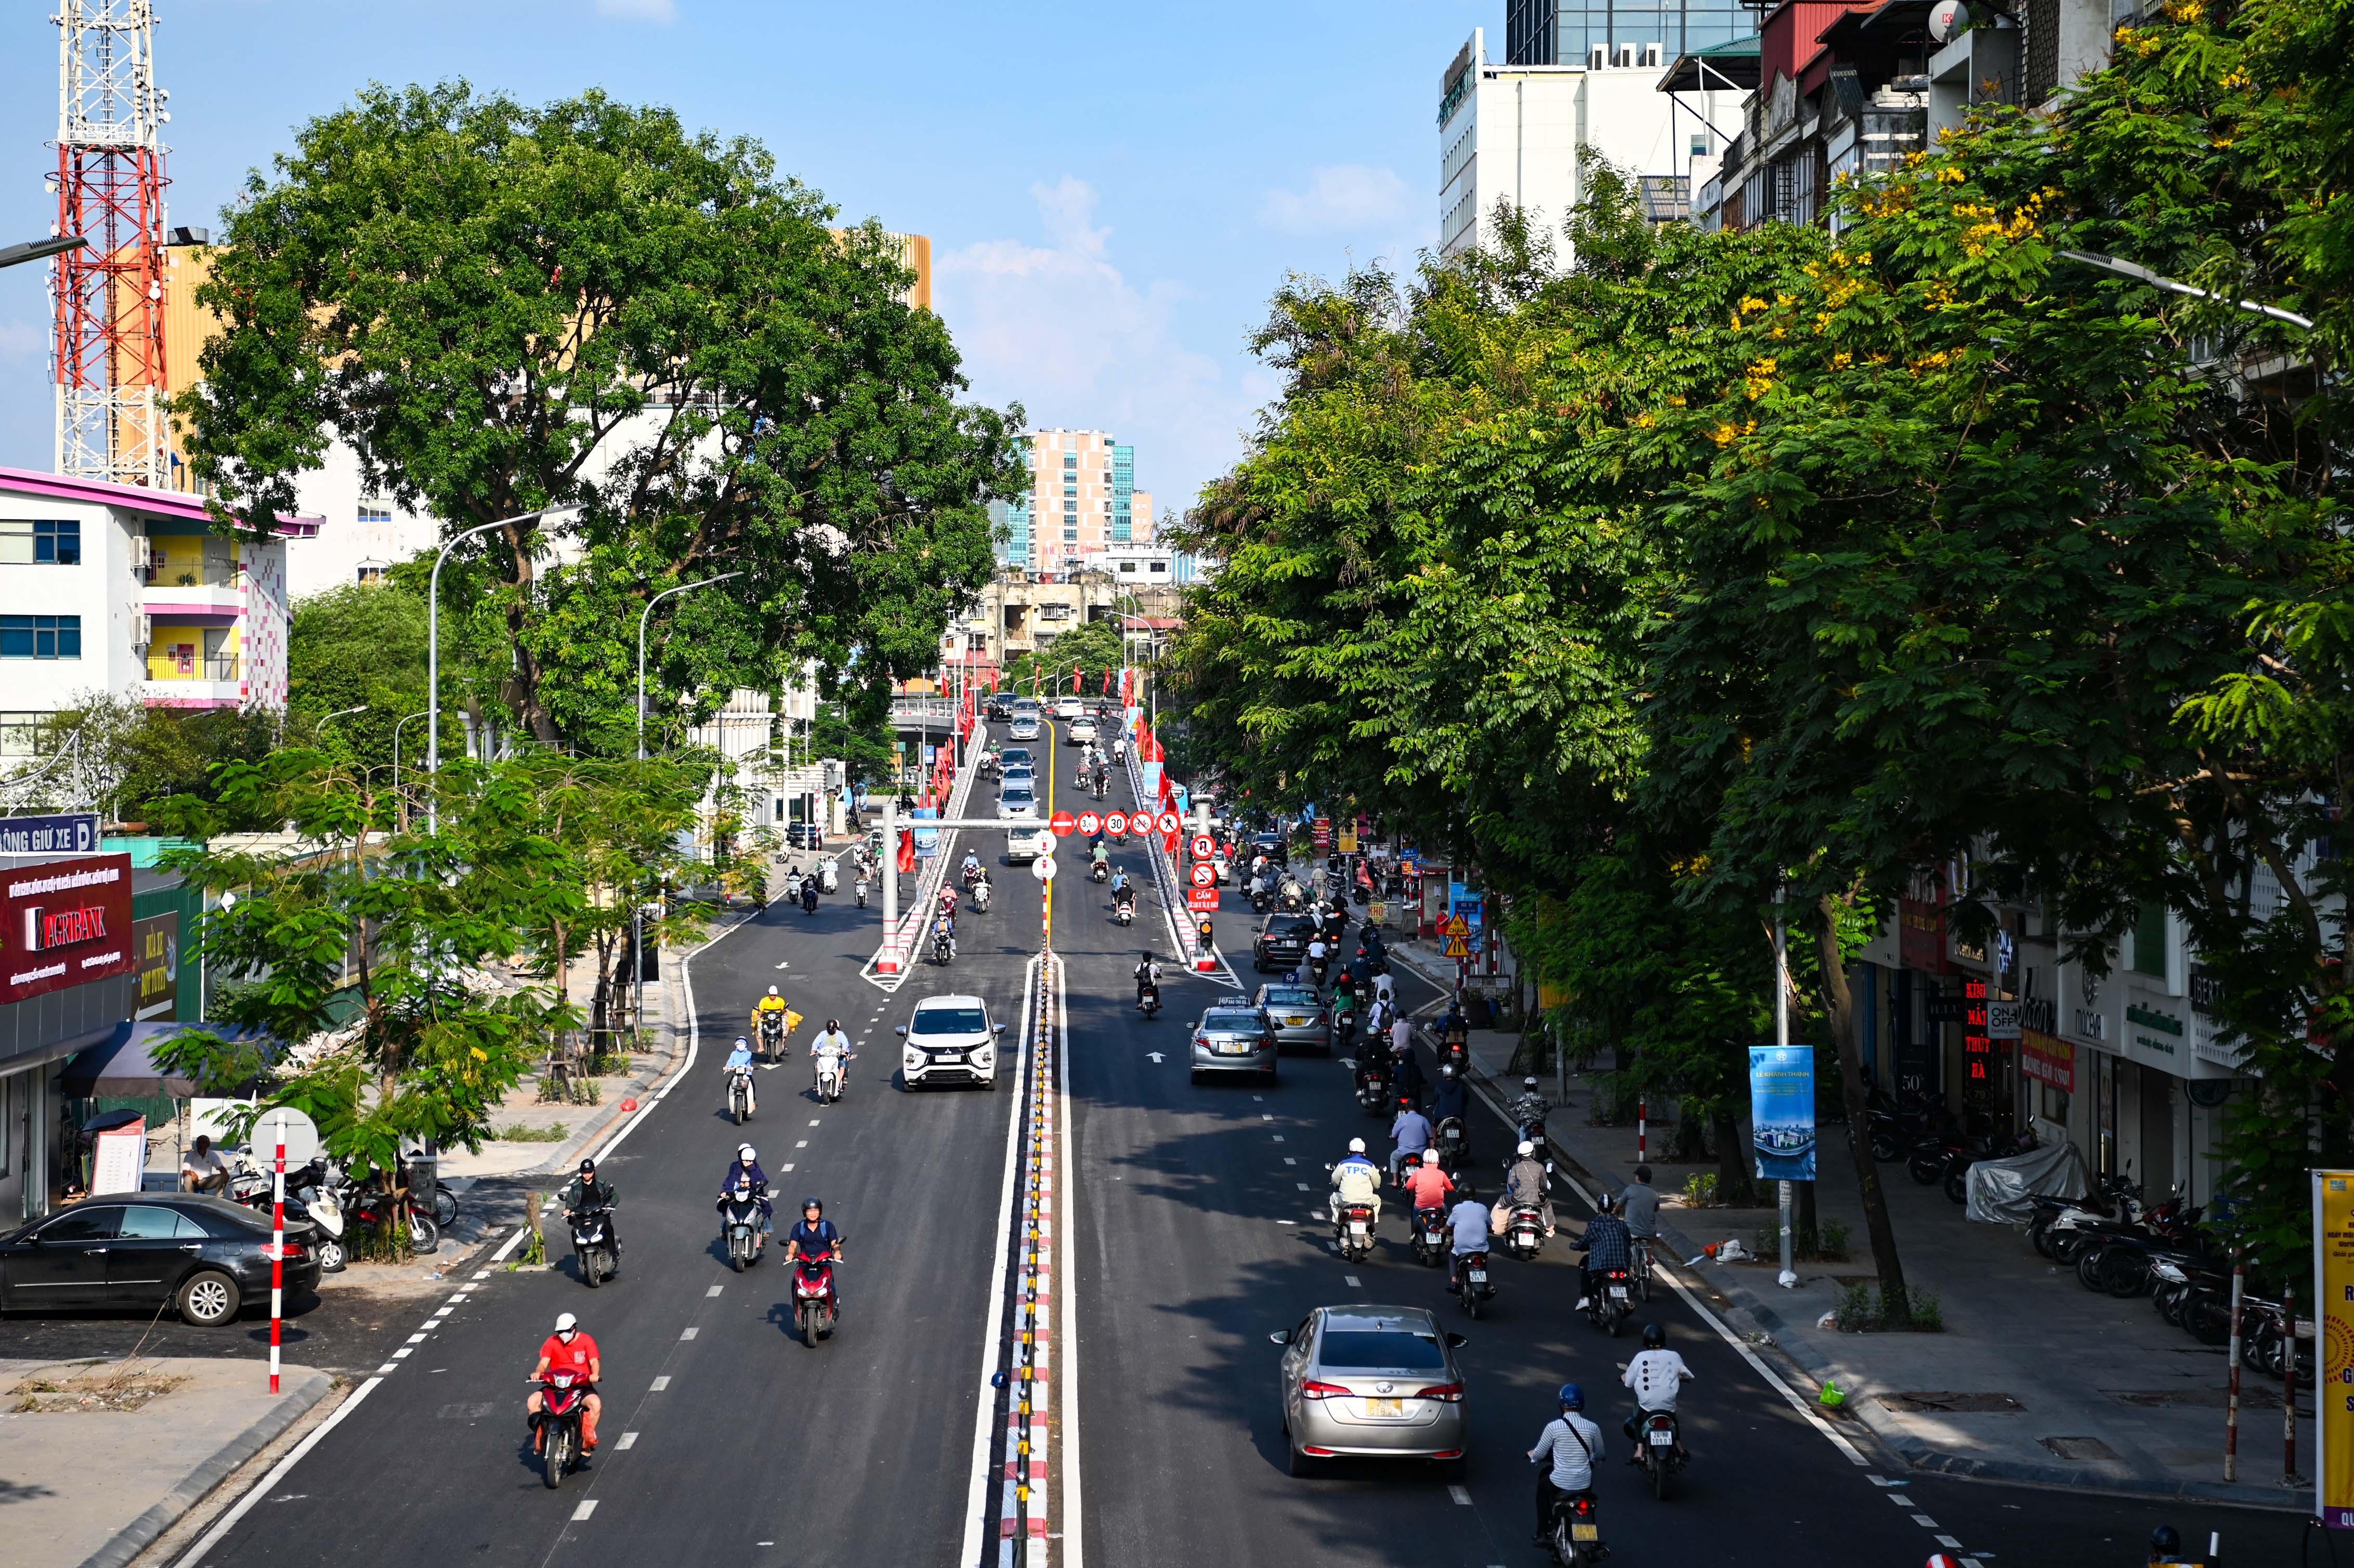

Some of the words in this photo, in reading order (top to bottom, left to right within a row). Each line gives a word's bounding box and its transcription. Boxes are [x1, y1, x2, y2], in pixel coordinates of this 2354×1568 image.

[1111, 819, 1122, 829] 30
[56, 828, 71, 848] XE
[77, 823, 90, 851] P
[1196, 890, 1211, 899] CẤM
[47, 906, 107, 948] AGRIBANK
[1345, 1166, 1368, 1175] TPC
